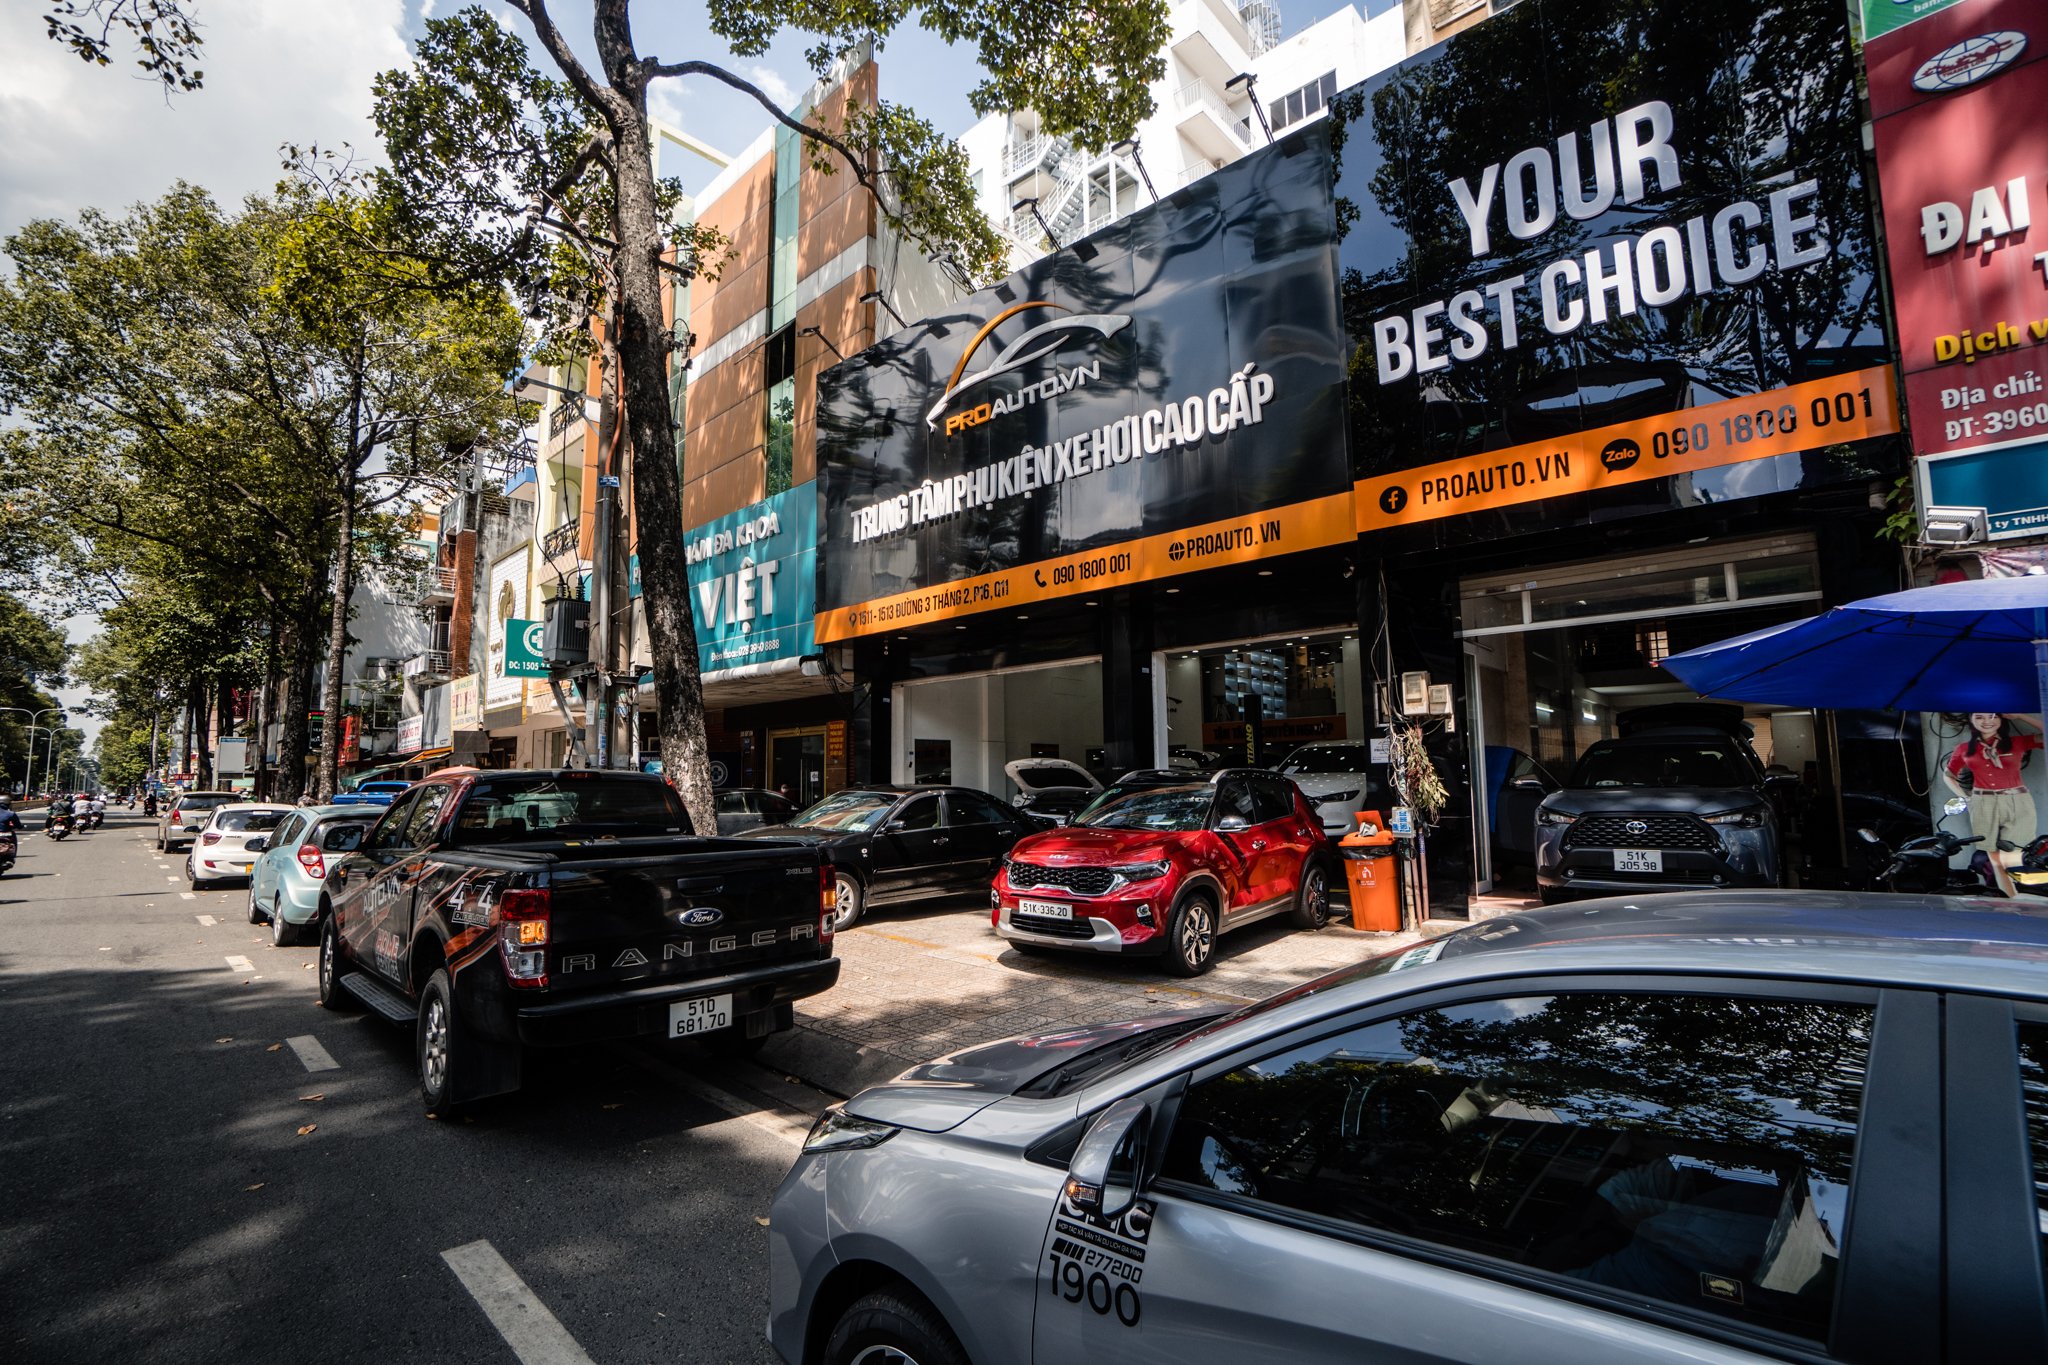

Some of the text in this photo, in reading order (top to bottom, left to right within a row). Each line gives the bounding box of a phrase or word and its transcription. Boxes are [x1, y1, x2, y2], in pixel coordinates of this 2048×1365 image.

[1448, 100, 1682, 258] YOUR
[1921, 176, 2030, 254] ĐẠI
[1373, 178, 1827, 385] BEST CHOICE
[1935, 321, 2020, 363] Dịch
[946, 360, 1100, 436] PROAUTO.VN
[1941, 370, 2042, 410] Địa chỉ:
[1605, 388, 1872, 463] Zalo 090 1800 001
[851, 361, 1274, 543] TRUNG TÂM PHỤ KIỆN XE HƠI CAO CẤP
[1422, 452, 1570, 504] PROAUTO.VN
[714, 530, 734, 555] ĐA
[736, 512, 780, 547] KHOA
[1187, 520, 1281, 558] PROAUTO.VN
[1053, 552, 1131, 586] 090 1800 001
[698, 556, 779, 634] VIỆT
[858, 610, 873, 626] 1511
[878, 604, 894, 622] 1513
[896, 597, 923, 618] ĐƯỜNG
[924, 596, 931, 612] 3
[933, 588, 962, 611] THÁNG
[1245, 723, 1255, 764] TITANO
[1619, 861, 1657, 871] 305.98
[1626, 851, 1648, 861] 51K
[690, 911, 715, 923] Ford
[562, 923, 814, 974] RANGER
[677, 1012, 726, 1035] 681.70
[688, 998, 716, 1017] 51D
[1084, 1249, 1143, 1284] 277200
[1050, 1253, 1141, 1327] 1900
